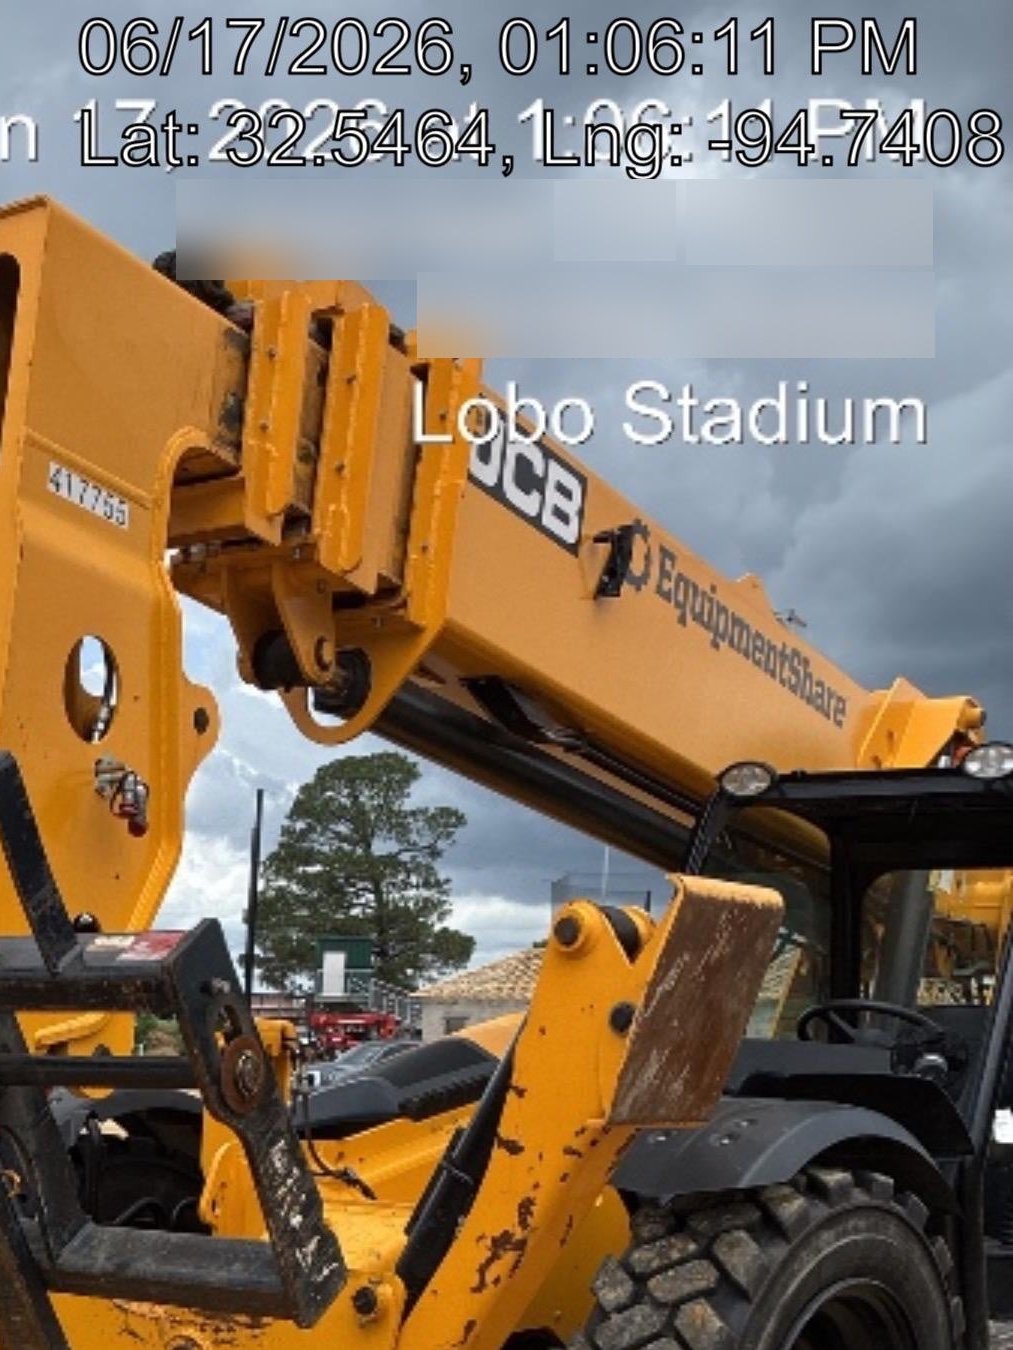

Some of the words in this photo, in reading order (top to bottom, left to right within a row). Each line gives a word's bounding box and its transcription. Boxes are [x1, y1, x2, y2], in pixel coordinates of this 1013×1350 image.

[49, 467, 126, 526] 417755
[469, 410, 583, 544] JCB
[656, 543, 847, 729] EquipmentShare
